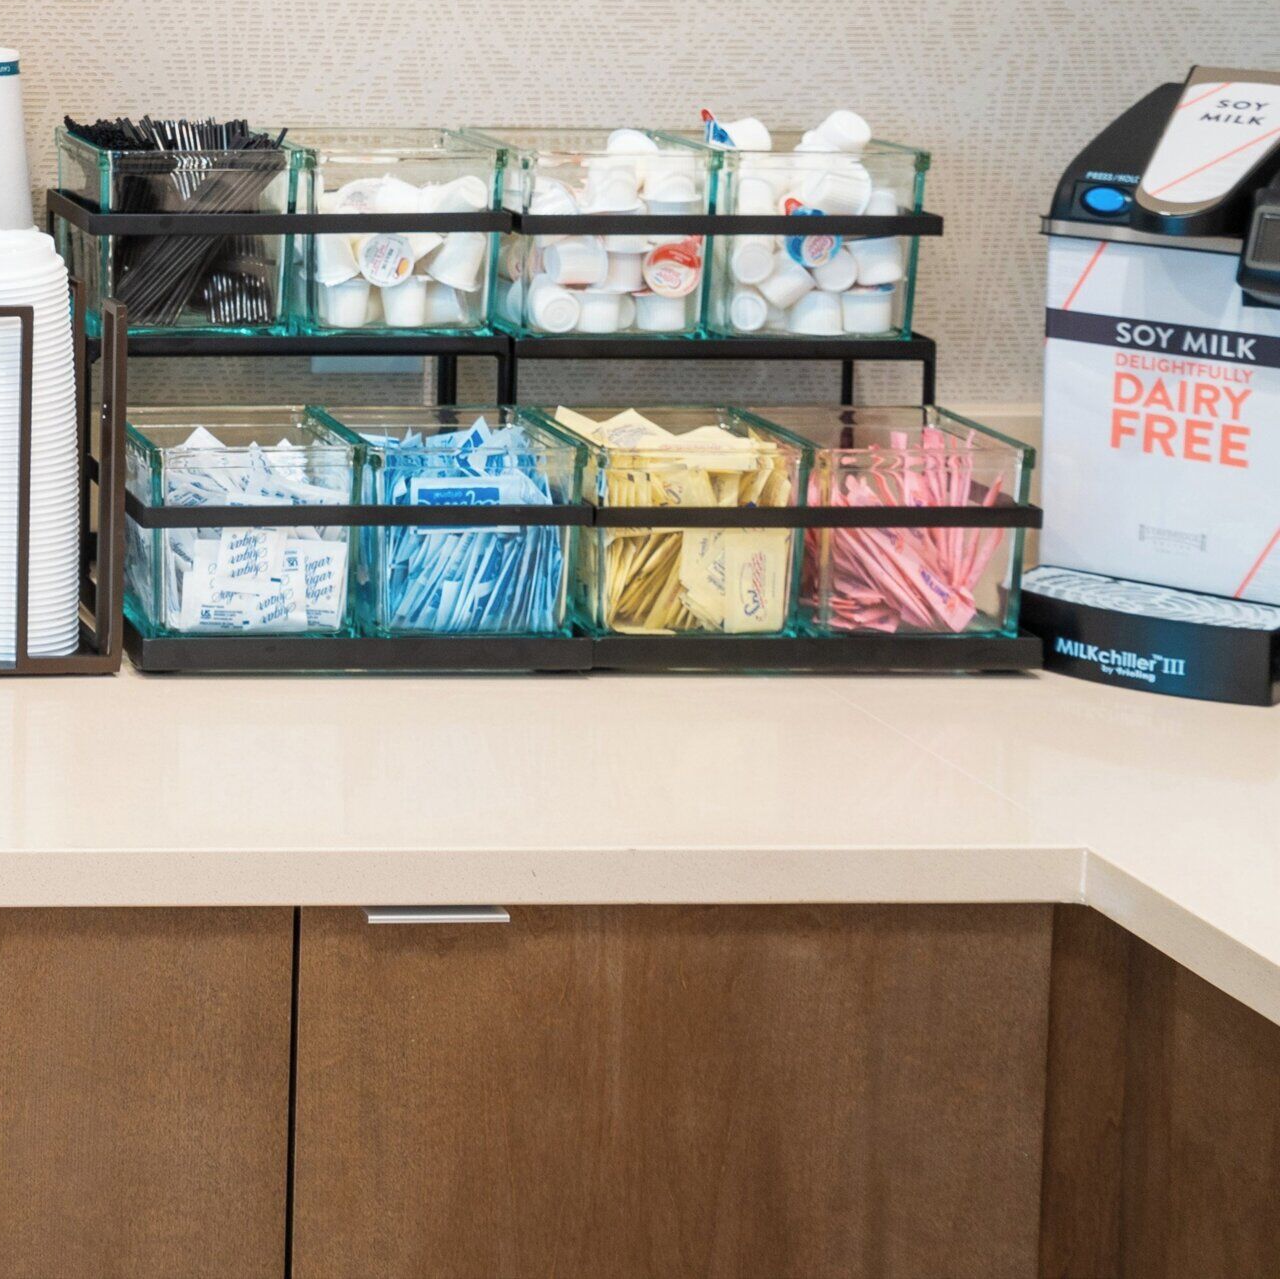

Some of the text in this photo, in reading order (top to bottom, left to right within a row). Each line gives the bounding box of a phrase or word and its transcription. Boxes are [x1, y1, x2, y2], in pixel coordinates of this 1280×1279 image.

[1216, 99, 1270, 111] SOY
[1200, 113, 1267, 126] MILK
[1115, 322, 1258, 361] SOY MILK
[1114, 351, 1254, 384] DELIGHTFULLY
[1112, 370, 1254, 421] DAIRY
[1110, 407, 1252, 468] FREE
[229, 531, 267, 551] Sugar
[230, 546, 268, 564] Sugar
[305, 555, 334, 573] ugar
[231, 561, 269, 579] Sugar
[1161, 657, 1186, 676] III
